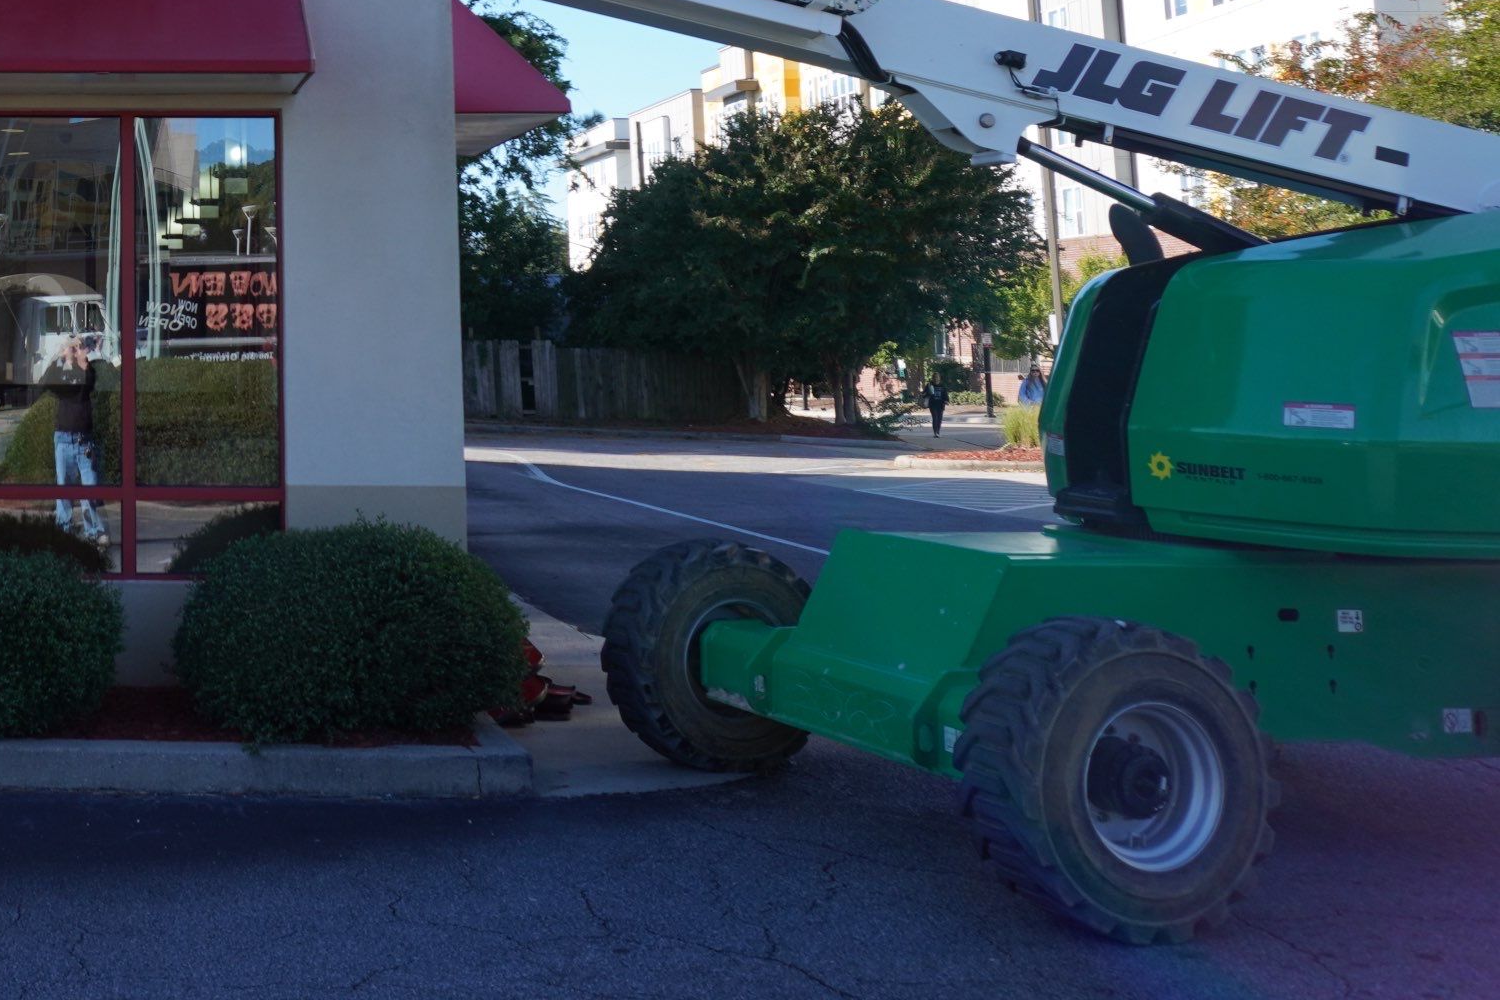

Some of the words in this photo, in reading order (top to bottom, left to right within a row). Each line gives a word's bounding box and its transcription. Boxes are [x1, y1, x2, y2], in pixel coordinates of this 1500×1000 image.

[1031, 42, 1187, 117] JLG
[1190, 78, 1372, 162] LIFT
[1176, 461, 1246, 481] SUNBELT
